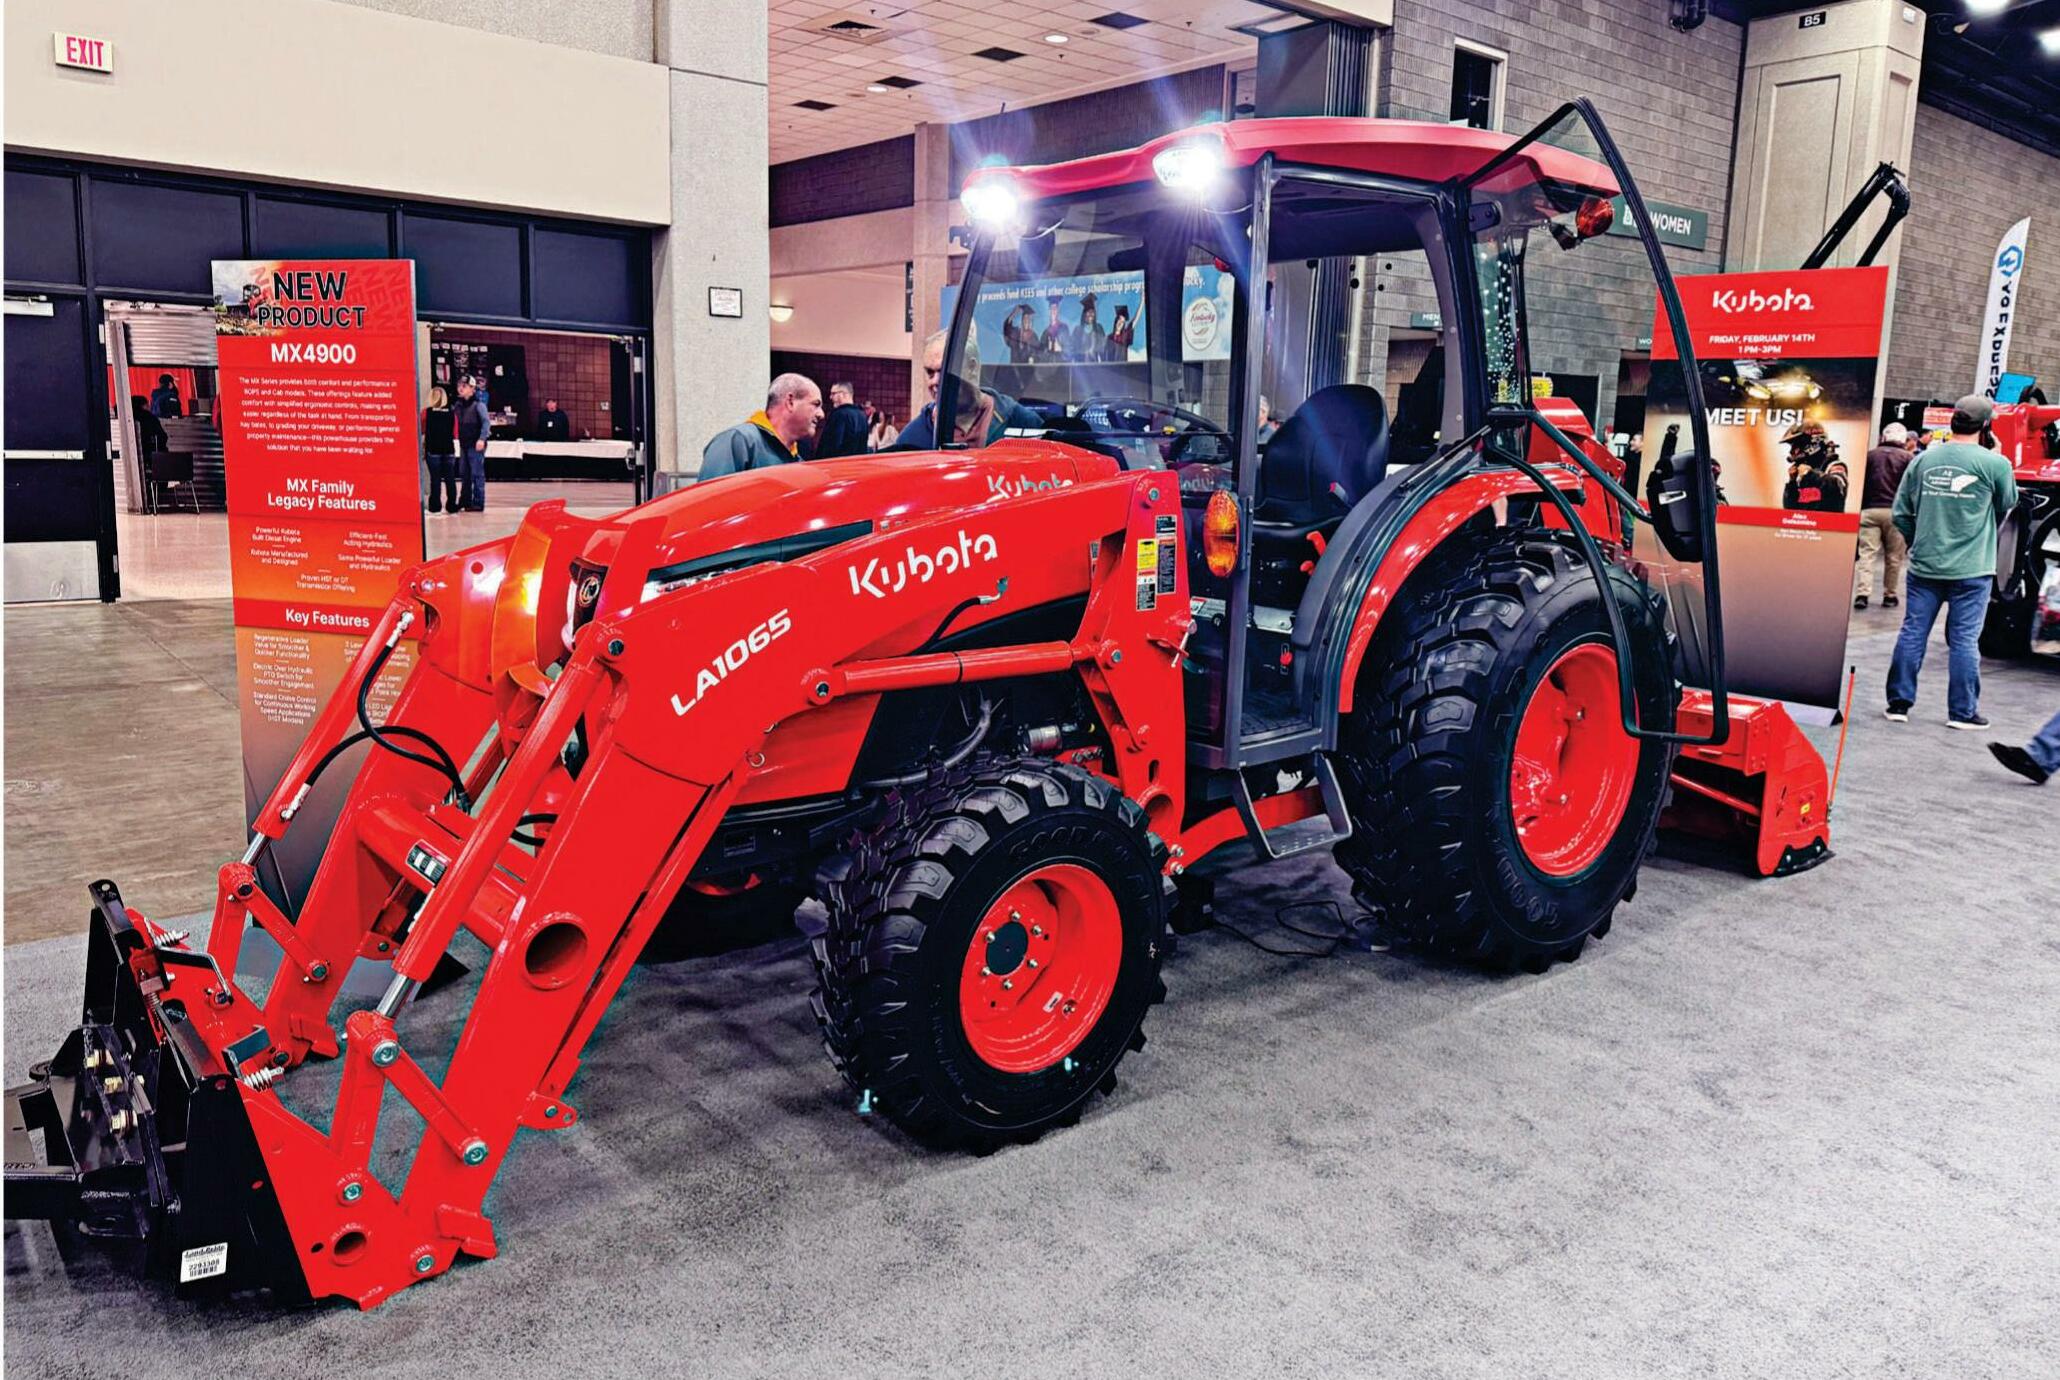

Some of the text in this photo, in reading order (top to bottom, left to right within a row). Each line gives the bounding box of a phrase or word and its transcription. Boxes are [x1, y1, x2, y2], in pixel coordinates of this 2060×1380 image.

[1804, 15, 1821, 26] B5
[66, 36, 104, 67] EXIT
[1649, 211, 1692, 236] WOMEN
[272, 271, 347, 302] NEW
[1712, 288, 1814, 313] Kubota
[258, 306, 366, 328] PRODUCT
[1709, 333, 1816, 345] FRIDAY, FEBRUARY 14TH
[271, 343, 356, 364] MX4900
[1706, 406, 1804, 426] MEET US!
[286, 477, 355, 497] MX Family
[267, 492, 377, 511] Legacy Features
[849, 530, 997, 598] Kubota
[286, 608, 370, 629] Key Features
[671, 608, 792, 716] LA1065
